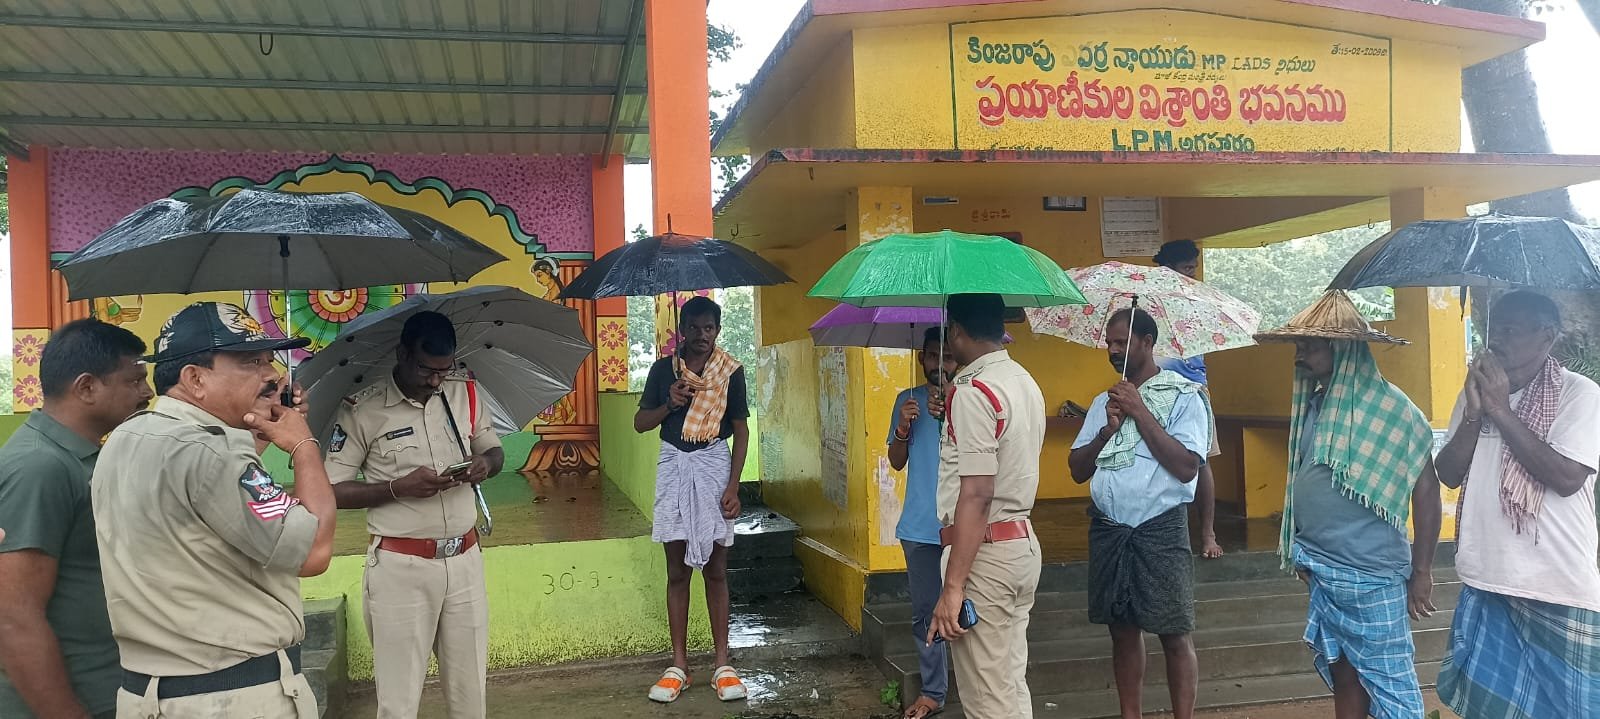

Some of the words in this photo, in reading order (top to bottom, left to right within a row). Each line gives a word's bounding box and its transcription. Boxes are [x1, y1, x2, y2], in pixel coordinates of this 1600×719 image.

[967, 36, 1056, 72] కింజరాపు
[1200, 54, 1227, 71] MP
[1231, 57, 1272, 71] LADS
[976, 70, 1134, 126] ప్రయాణీకుల
[1139, 84, 1232, 127] విశ్రాంతి
[1239, 84, 1347, 125] భవనము
